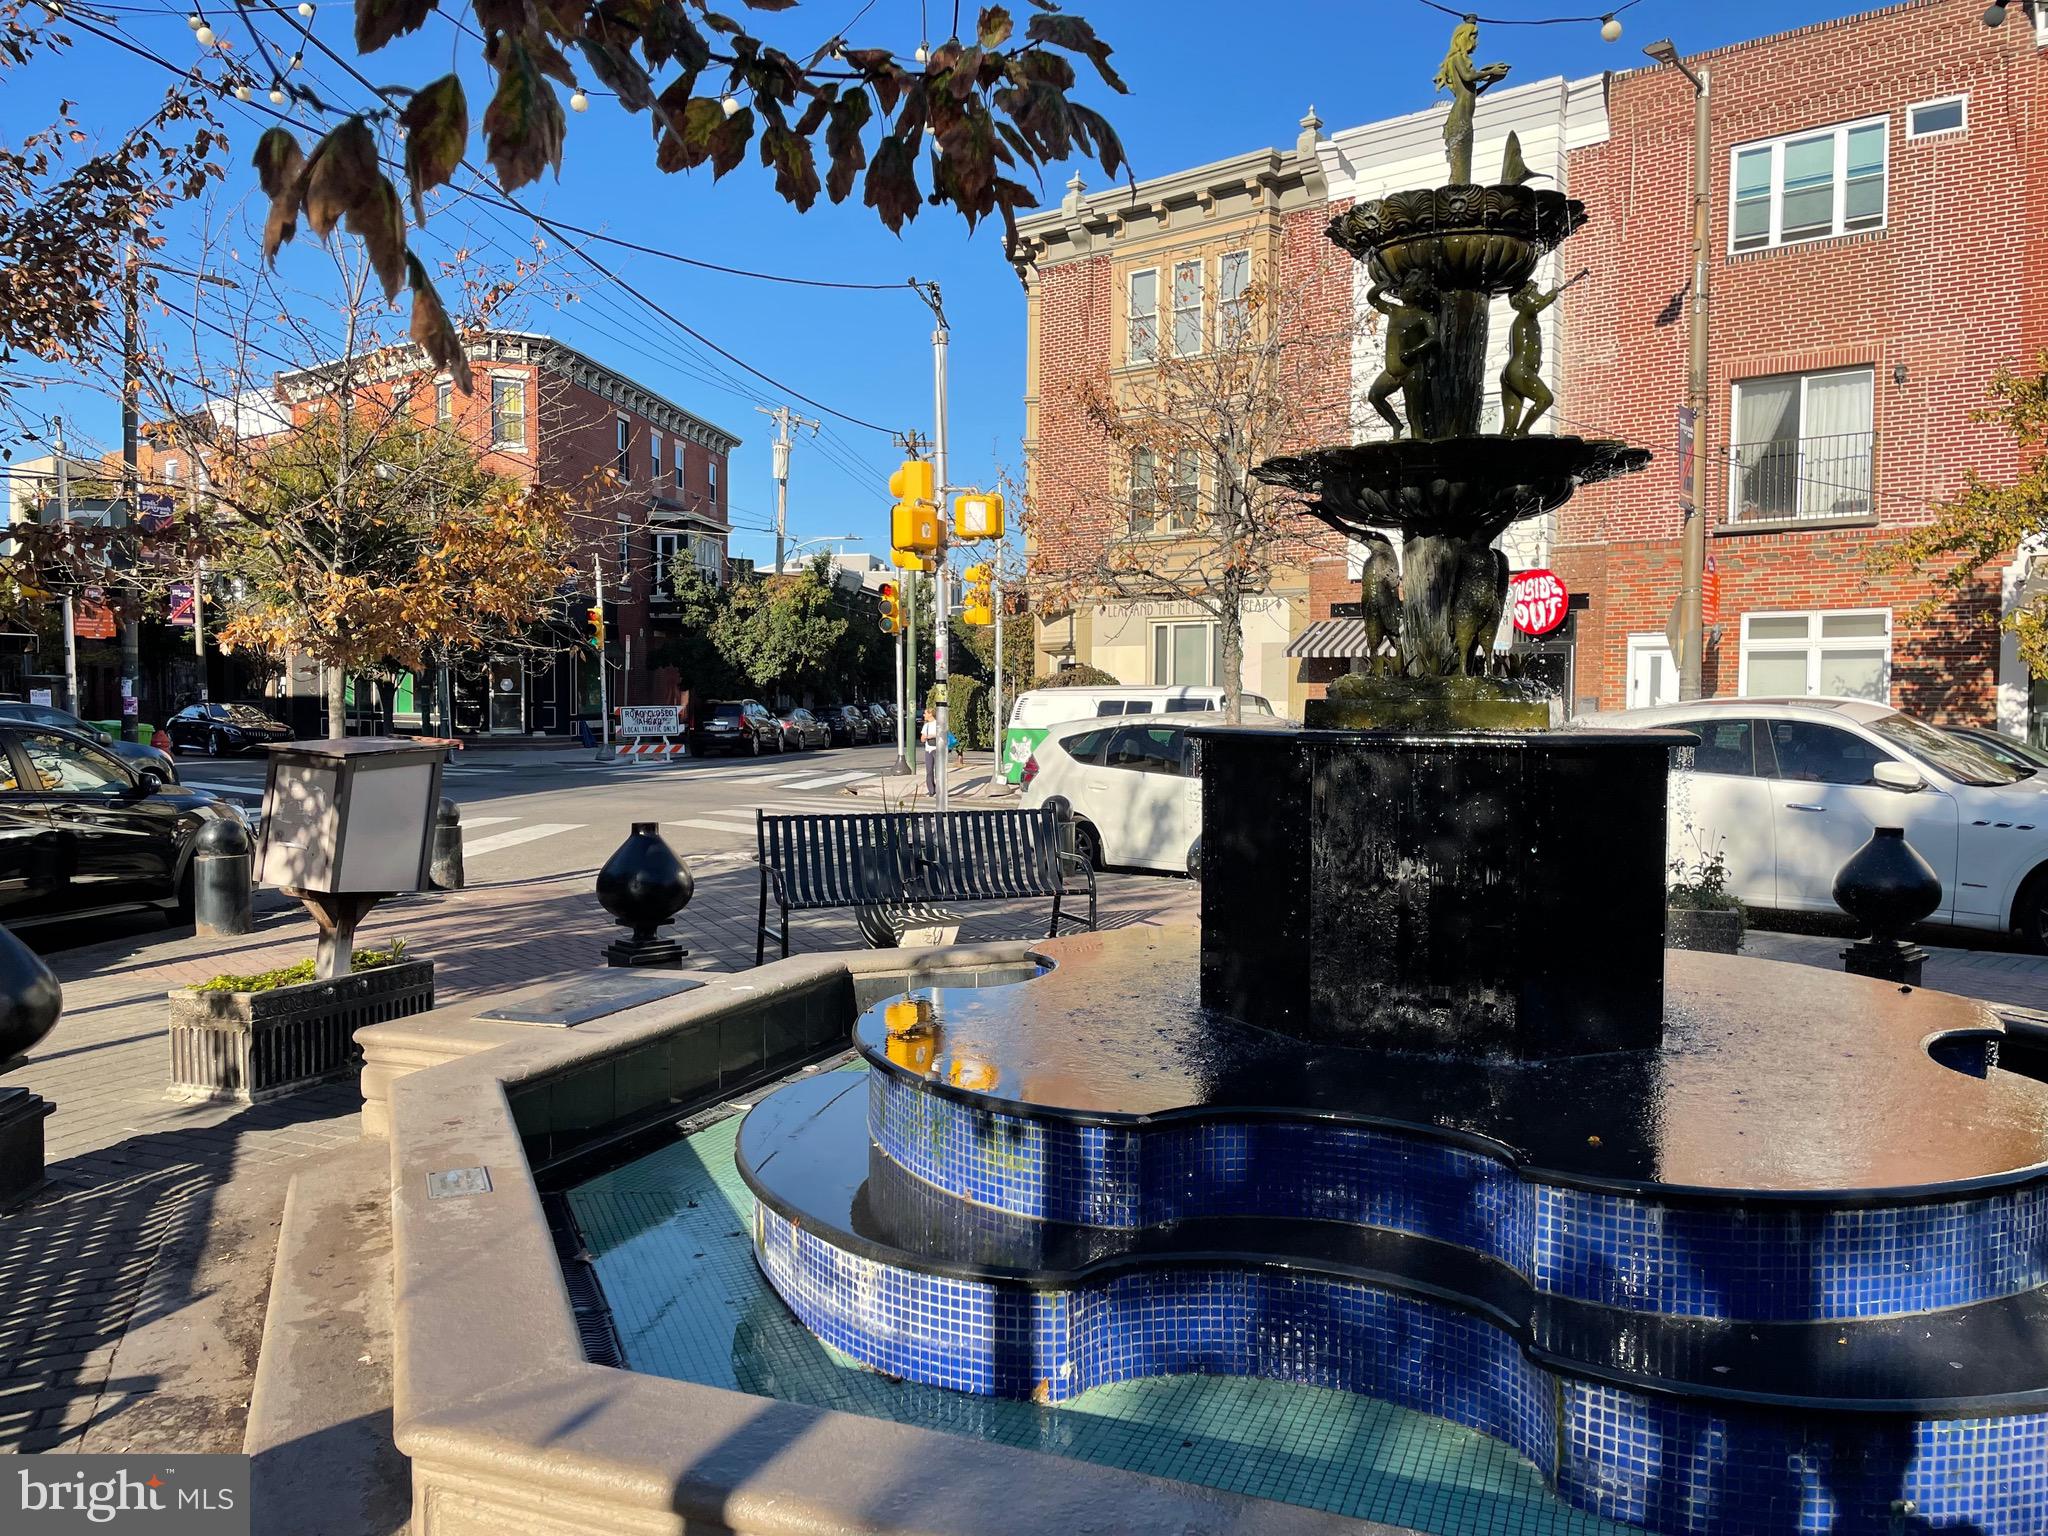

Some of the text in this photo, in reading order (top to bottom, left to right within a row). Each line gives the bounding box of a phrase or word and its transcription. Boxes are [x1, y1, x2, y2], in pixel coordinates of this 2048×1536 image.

[1513, 575, 1563, 604] NSIDE
[1133, 604, 1154, 617] AND
[1157, 602, 1175, 616] THE
[1178, 601, 1195, 615] NET
[1513, 596, 1562, 631] OUT
[624, 726, 640, 734] LOCAL
[642, 726, 662, 734] TRAFFIC
